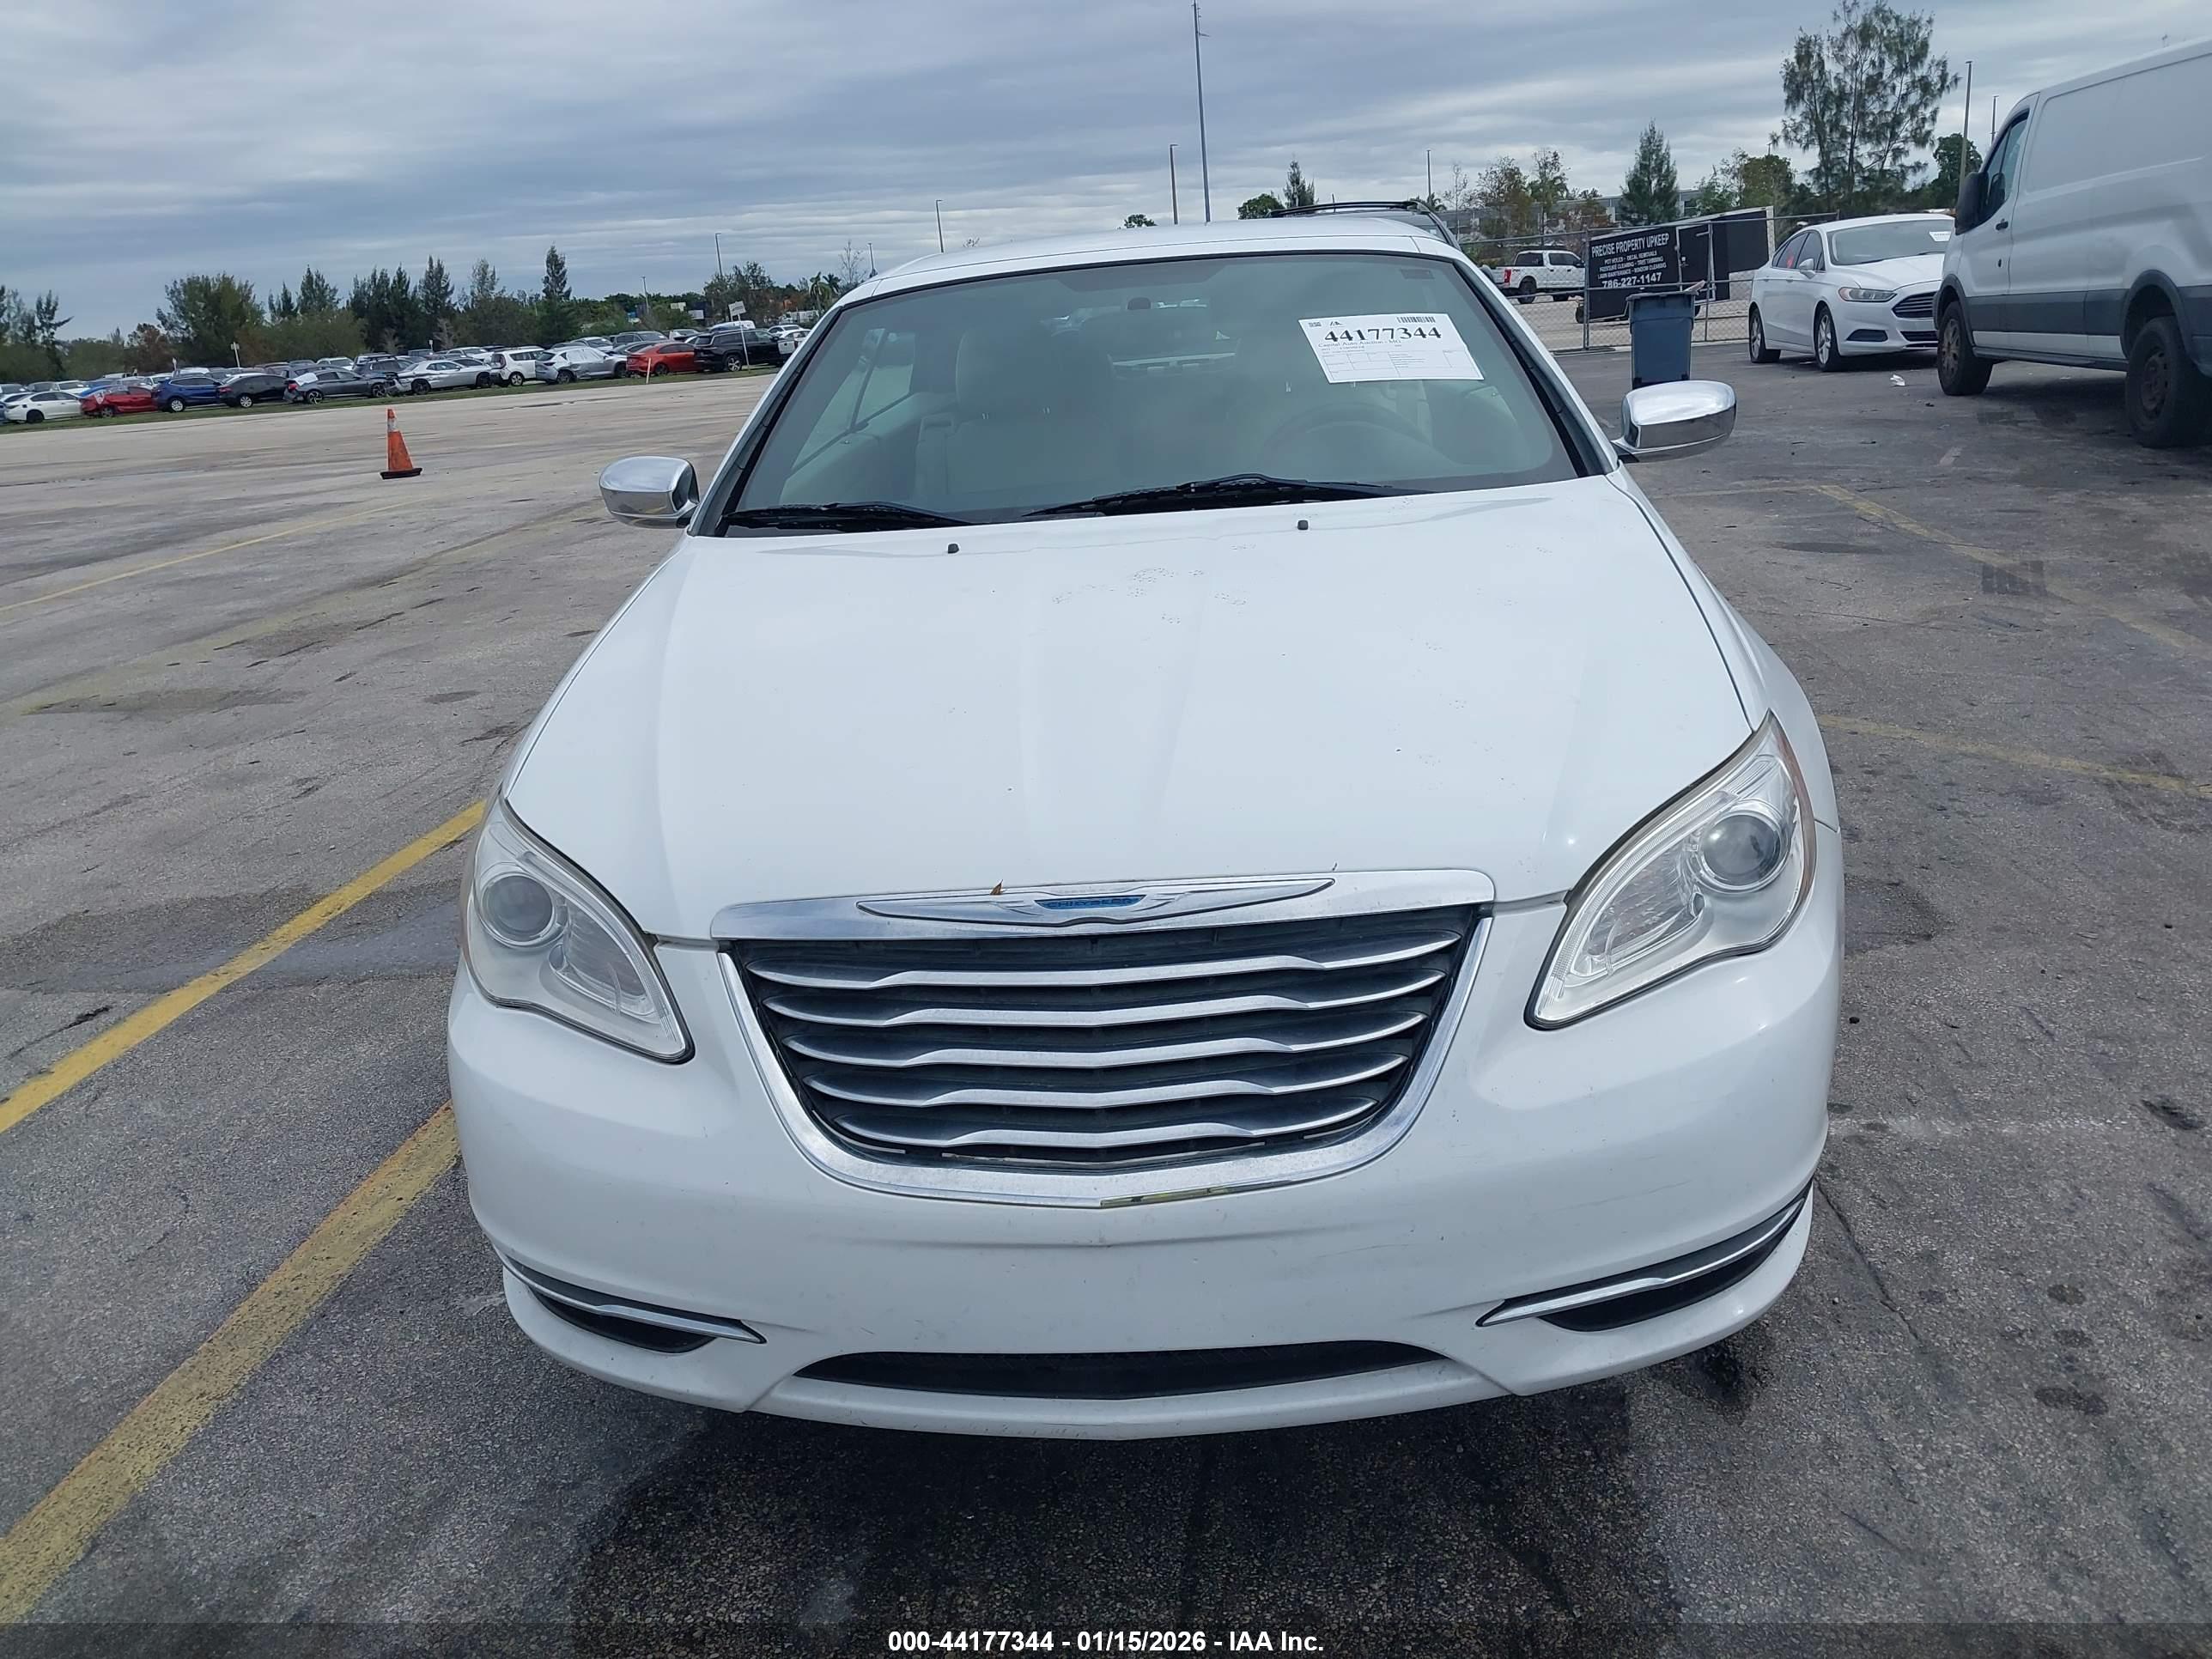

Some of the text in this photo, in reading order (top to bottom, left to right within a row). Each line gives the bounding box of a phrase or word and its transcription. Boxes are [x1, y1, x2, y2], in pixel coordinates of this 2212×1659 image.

[1591, 233, 1669, 258] PRECISE PROPERTY UPKEEP
[1601, 271, 1662, 289] 786-227-1147
[1325, 327, 1442, 342] 44177344
